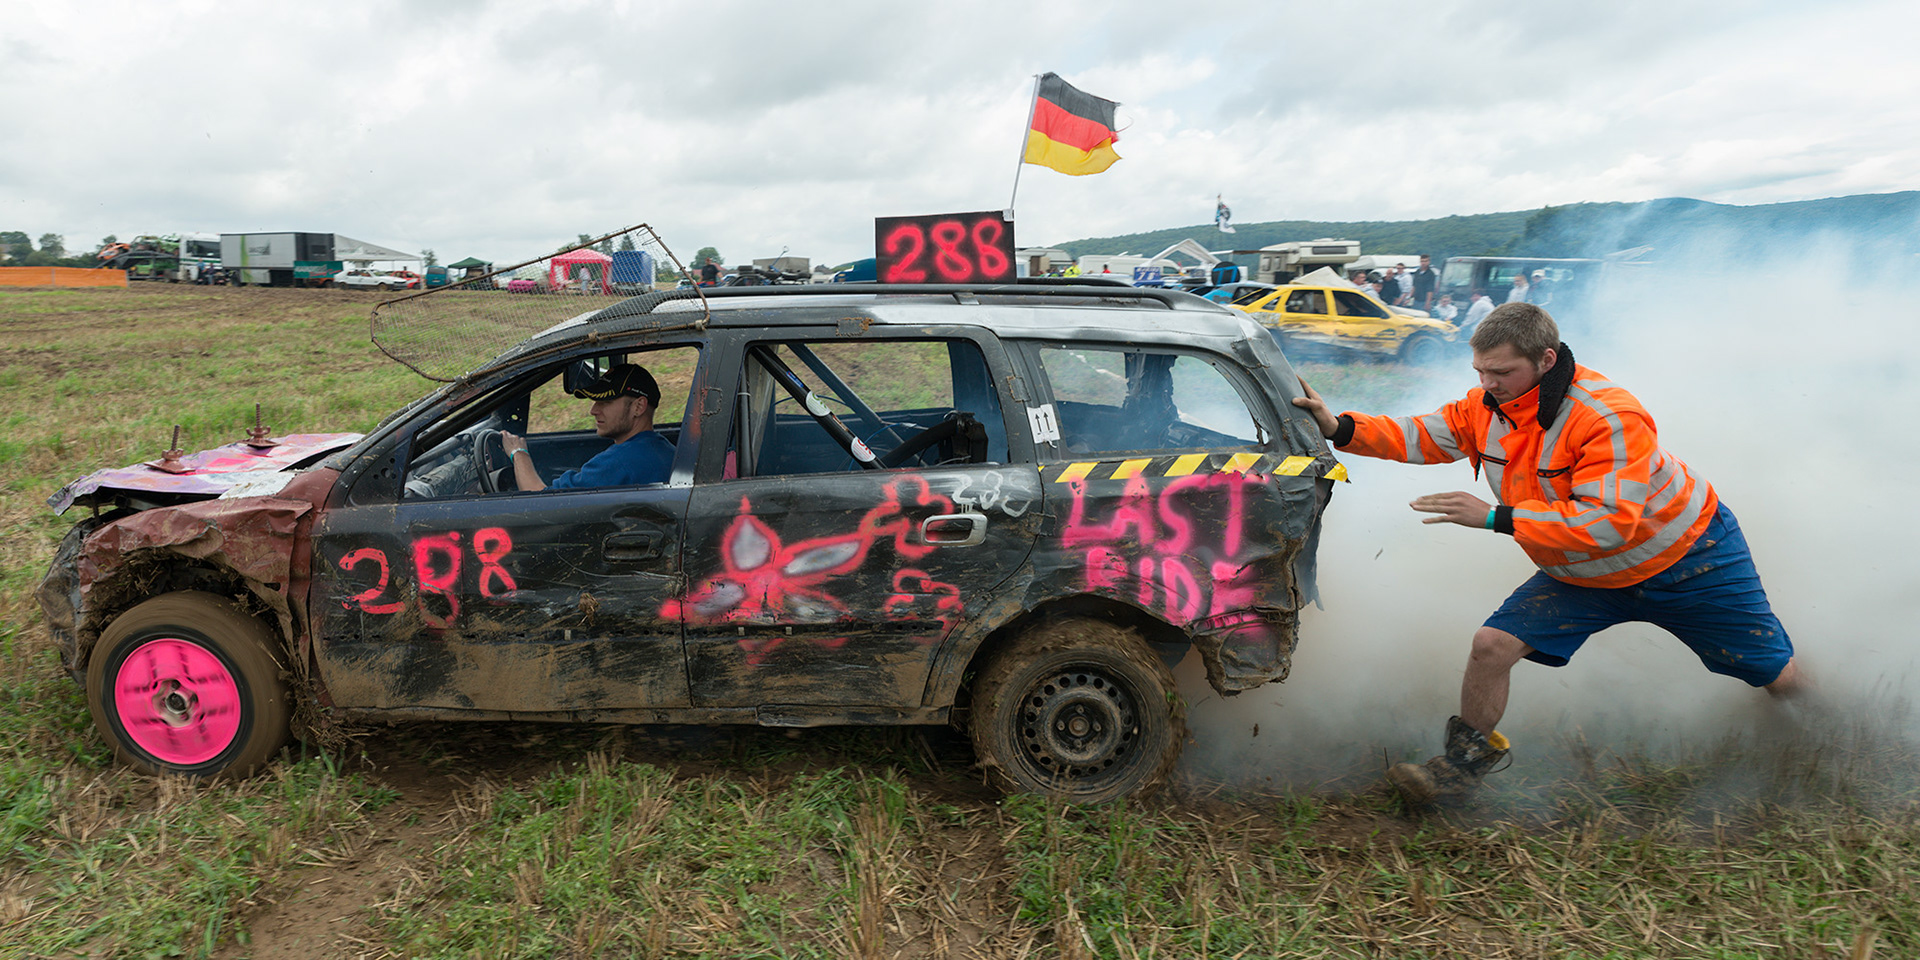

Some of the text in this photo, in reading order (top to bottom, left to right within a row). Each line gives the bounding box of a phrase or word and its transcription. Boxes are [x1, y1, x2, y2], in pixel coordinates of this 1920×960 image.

[886, 219, 1010, 284] 288
[1062, 471, 1270, 557] LAST
[338, 526, 518, 634] 288
[1085, 547, 1263, 638] RIDE
